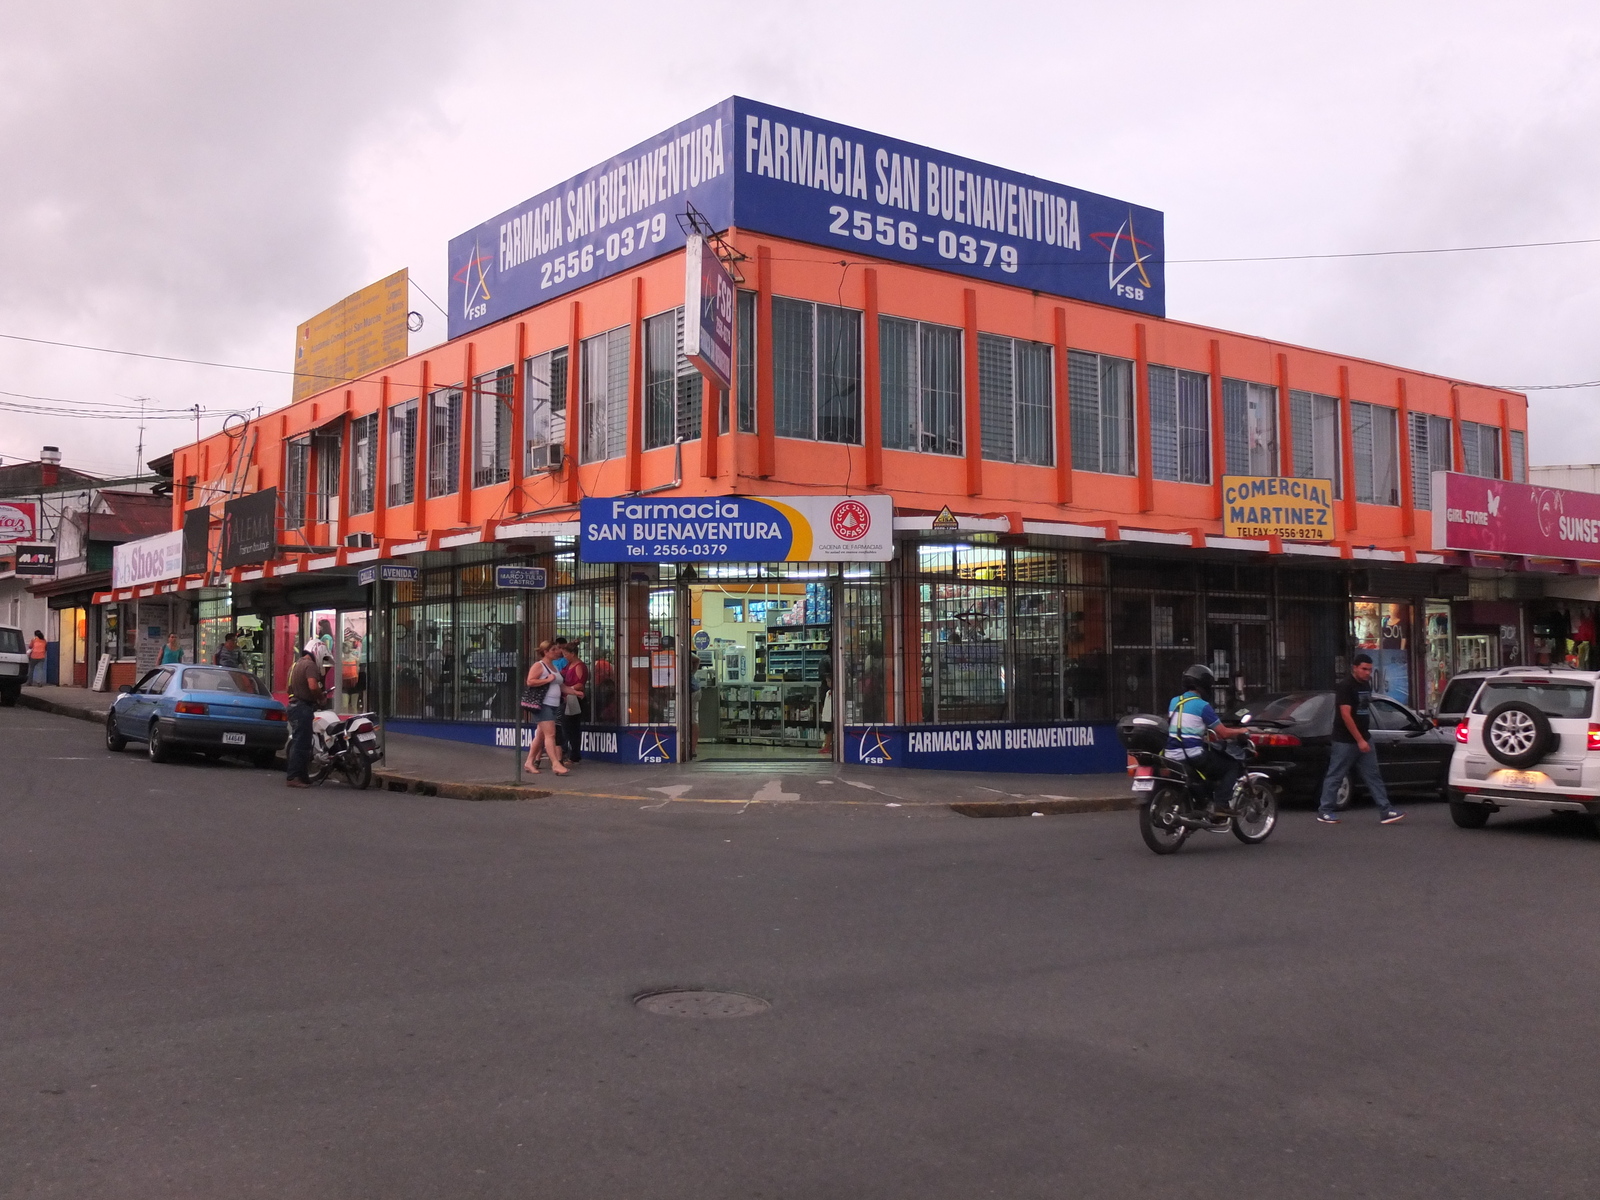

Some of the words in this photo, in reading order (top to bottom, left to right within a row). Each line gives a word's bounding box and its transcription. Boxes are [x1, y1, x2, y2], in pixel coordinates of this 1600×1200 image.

[746, 114, 868, 200] FARMACIA
[875, 148, 920, 213] SAN
[927, 161, 1081, 251] BUENAVENTURA
[500, 196, 563, 273] FARMACIA
[566, 180, 596, 243] SAN
[600, 118, 725, 229] BUENAVENTURA
[828, 205, 1019, 274] 2556-0379
[540, 212, 667, 290] 2556-0379
[716, 273, 732, 324] FSB
[1116, 283, 1145, 301] FSB
[469, 302, 487, 320] FSB
[1225, 478, 1331, 509] COMERCIAL
[612, 500, 739, 519] Farmacia
[1230, 506, 1328, 526] MARTINEZ
[1447, 508, 1464, 523] GIRL
[1465, 510, 1489, 526] STORE
[588, 523, 626, 541] SAN
[633, 522, 782, 541] BUENAVENTURA
[835, 523, 867, 537] COFASA
[626, 545, 648, 556] Tel.
[653, 544, 728, 556] 2556-0379
[131, 545, 164, 582] Shoes
[383, 568, 413, 578] AVENIDA
[413, 570, 419, 579] 2
[495, 727, 533, 747] FARMCIA
[908, 730, 974, 753] FARMACIA
[976, 729, 1002, 750] SAN
[1004, 726, 1095, 749] BUENAVENTURA
[865, 756, 884, 764] FSB
